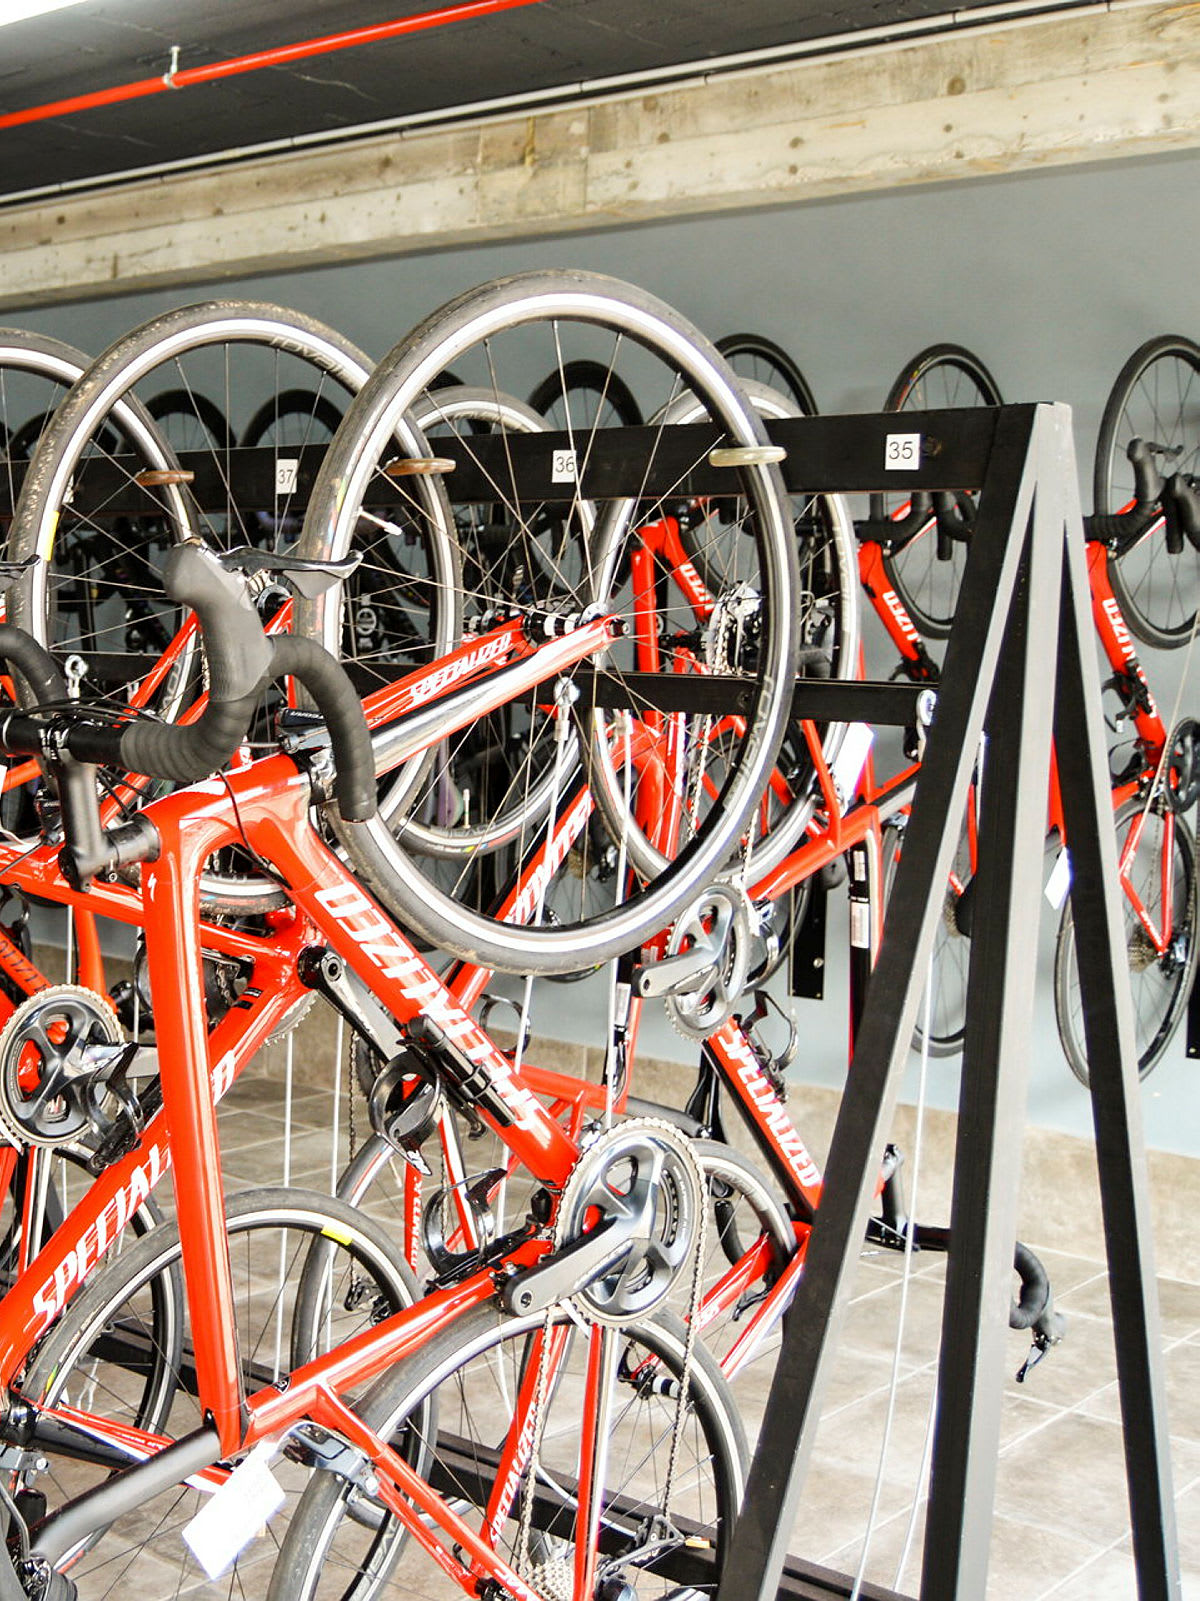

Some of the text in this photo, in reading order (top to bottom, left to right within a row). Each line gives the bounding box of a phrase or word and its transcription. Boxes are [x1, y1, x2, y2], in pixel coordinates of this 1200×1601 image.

[889, 441, 913, 459] 35
[556, 456, 575, 473] 36
[278, 469, 293, 484] 37
[717, 1029, 823, 1188] SPECIALIZED
